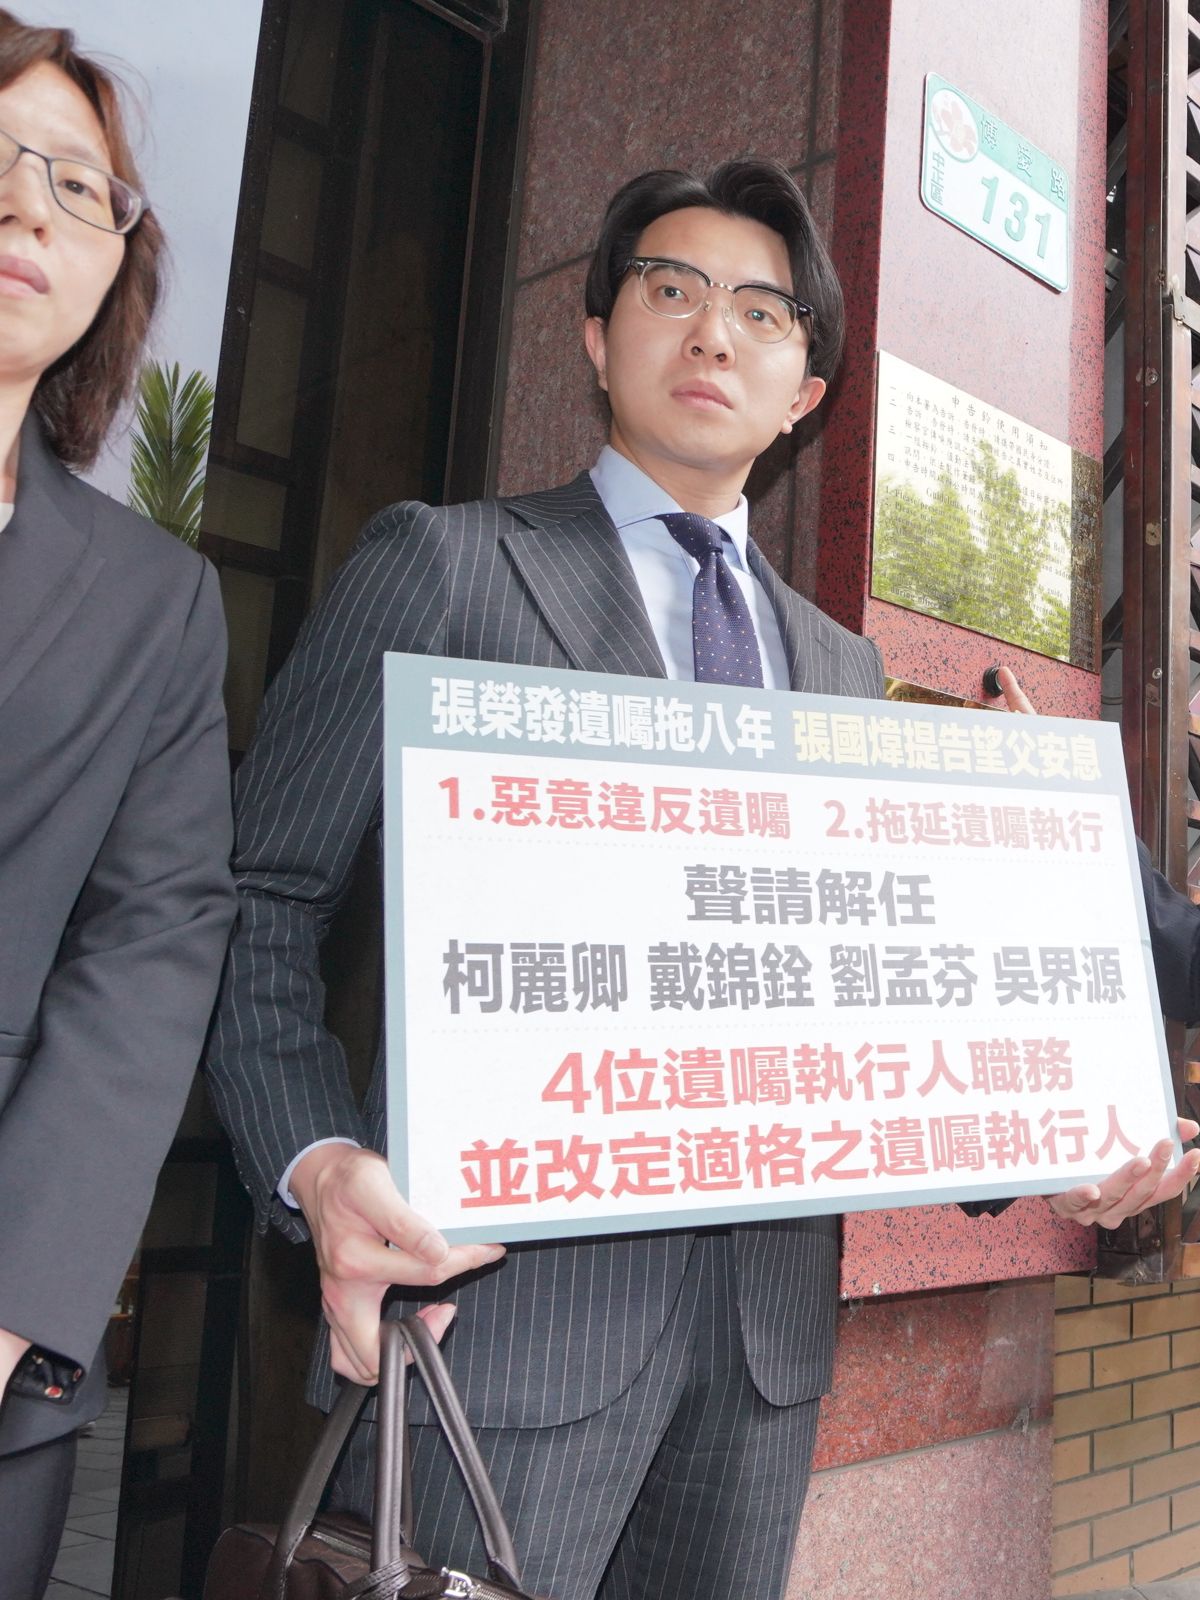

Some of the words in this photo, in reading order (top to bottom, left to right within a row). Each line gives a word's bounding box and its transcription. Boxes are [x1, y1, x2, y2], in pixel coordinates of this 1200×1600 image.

[980, 174, 1052, 260] 131
[431, 677, 775, 759] 張榮發遺囑拖八年
[792, 709, 1102, 782] 張國煒提告望父安息
[684, 864, 936, 927] 聲請解任
[443, 939, 629, 1014] 柯麗卿
[647, 941, 815, 1011] 戴錦銓
[830, 943, 978, 1008] 劉孟芬
[993, 945, 1127, 1006] 吳界源
[541, 1037, 1073, 1114] 4位遺囑執行人職務
[460, 1104, 1141, 1209] 並改定適格之遺囑執行人
